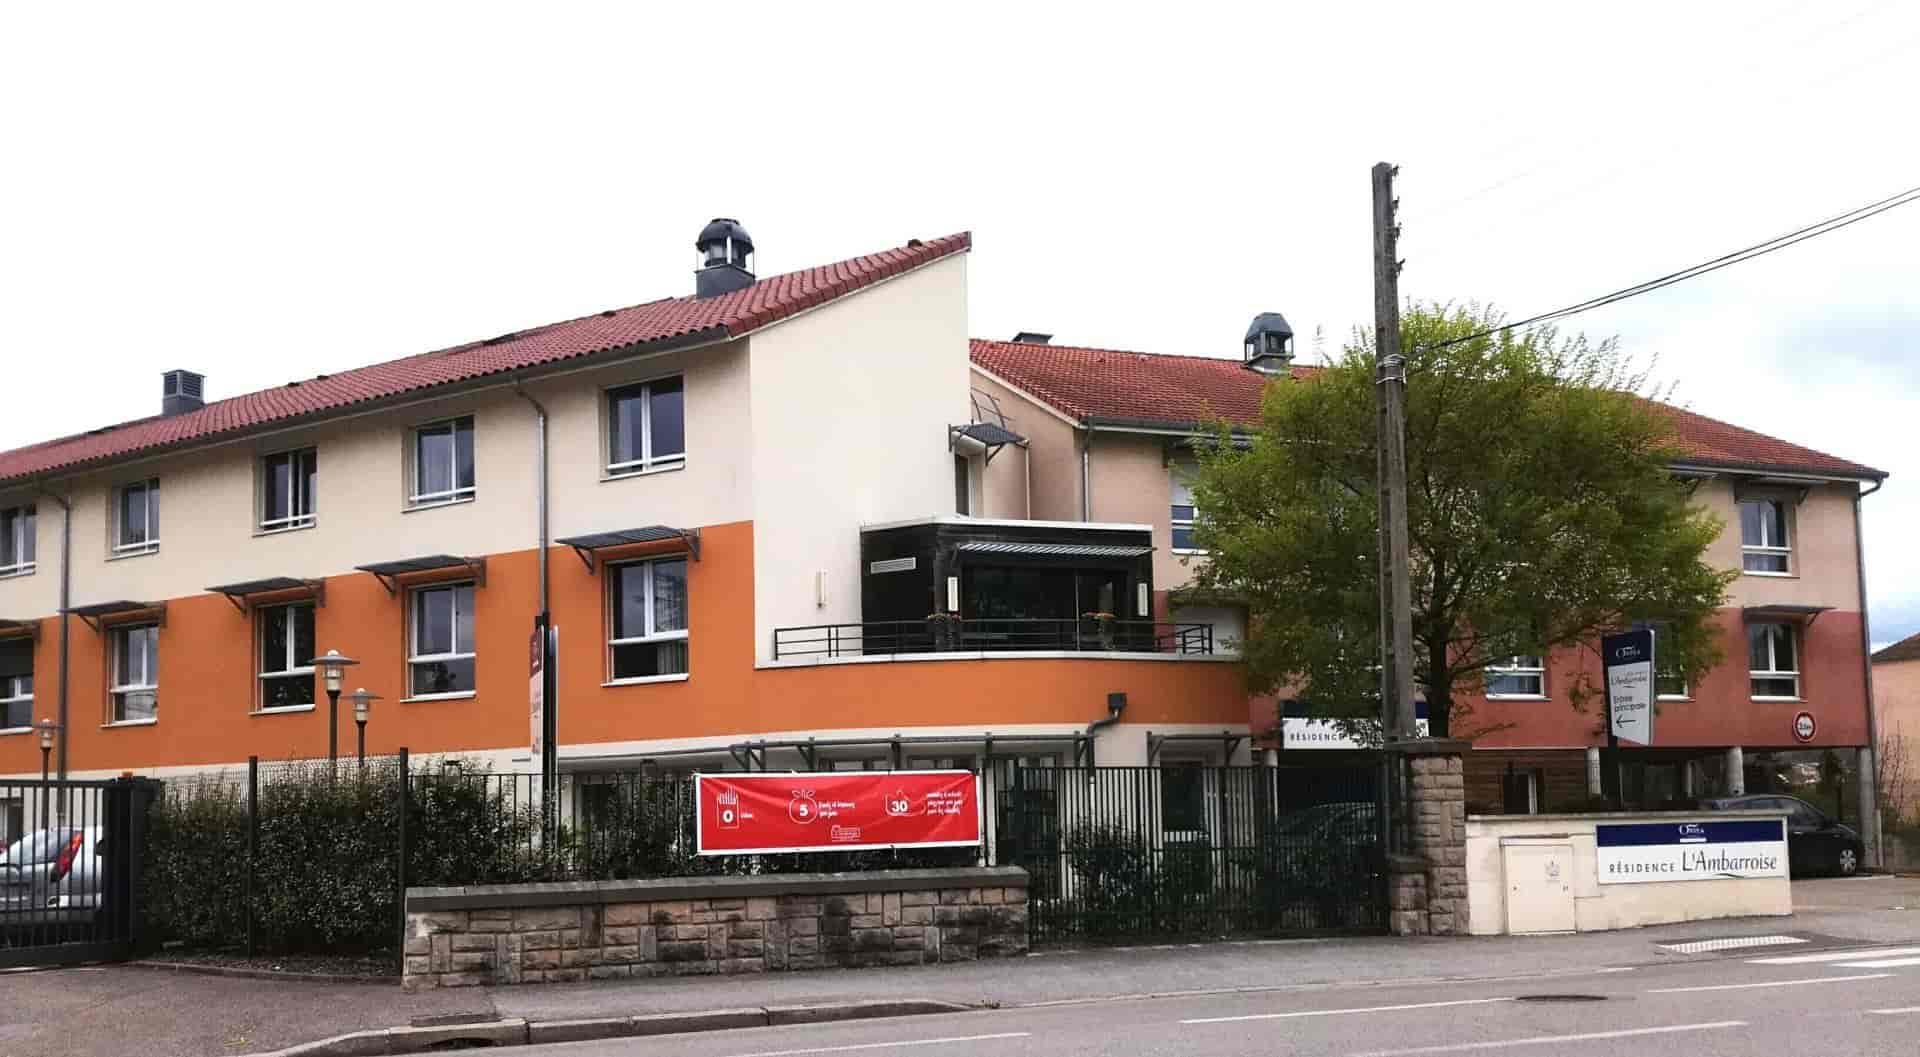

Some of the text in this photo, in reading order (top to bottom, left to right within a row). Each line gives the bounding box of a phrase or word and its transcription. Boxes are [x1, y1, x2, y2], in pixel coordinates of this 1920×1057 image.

[799, 804, 809, 817] 5
[891, 800, 908, 812] 30
[722, 810, 734, 823] 0
[1609, 849, 1777, 873] RÉSIDENCE L'Ambarroise
